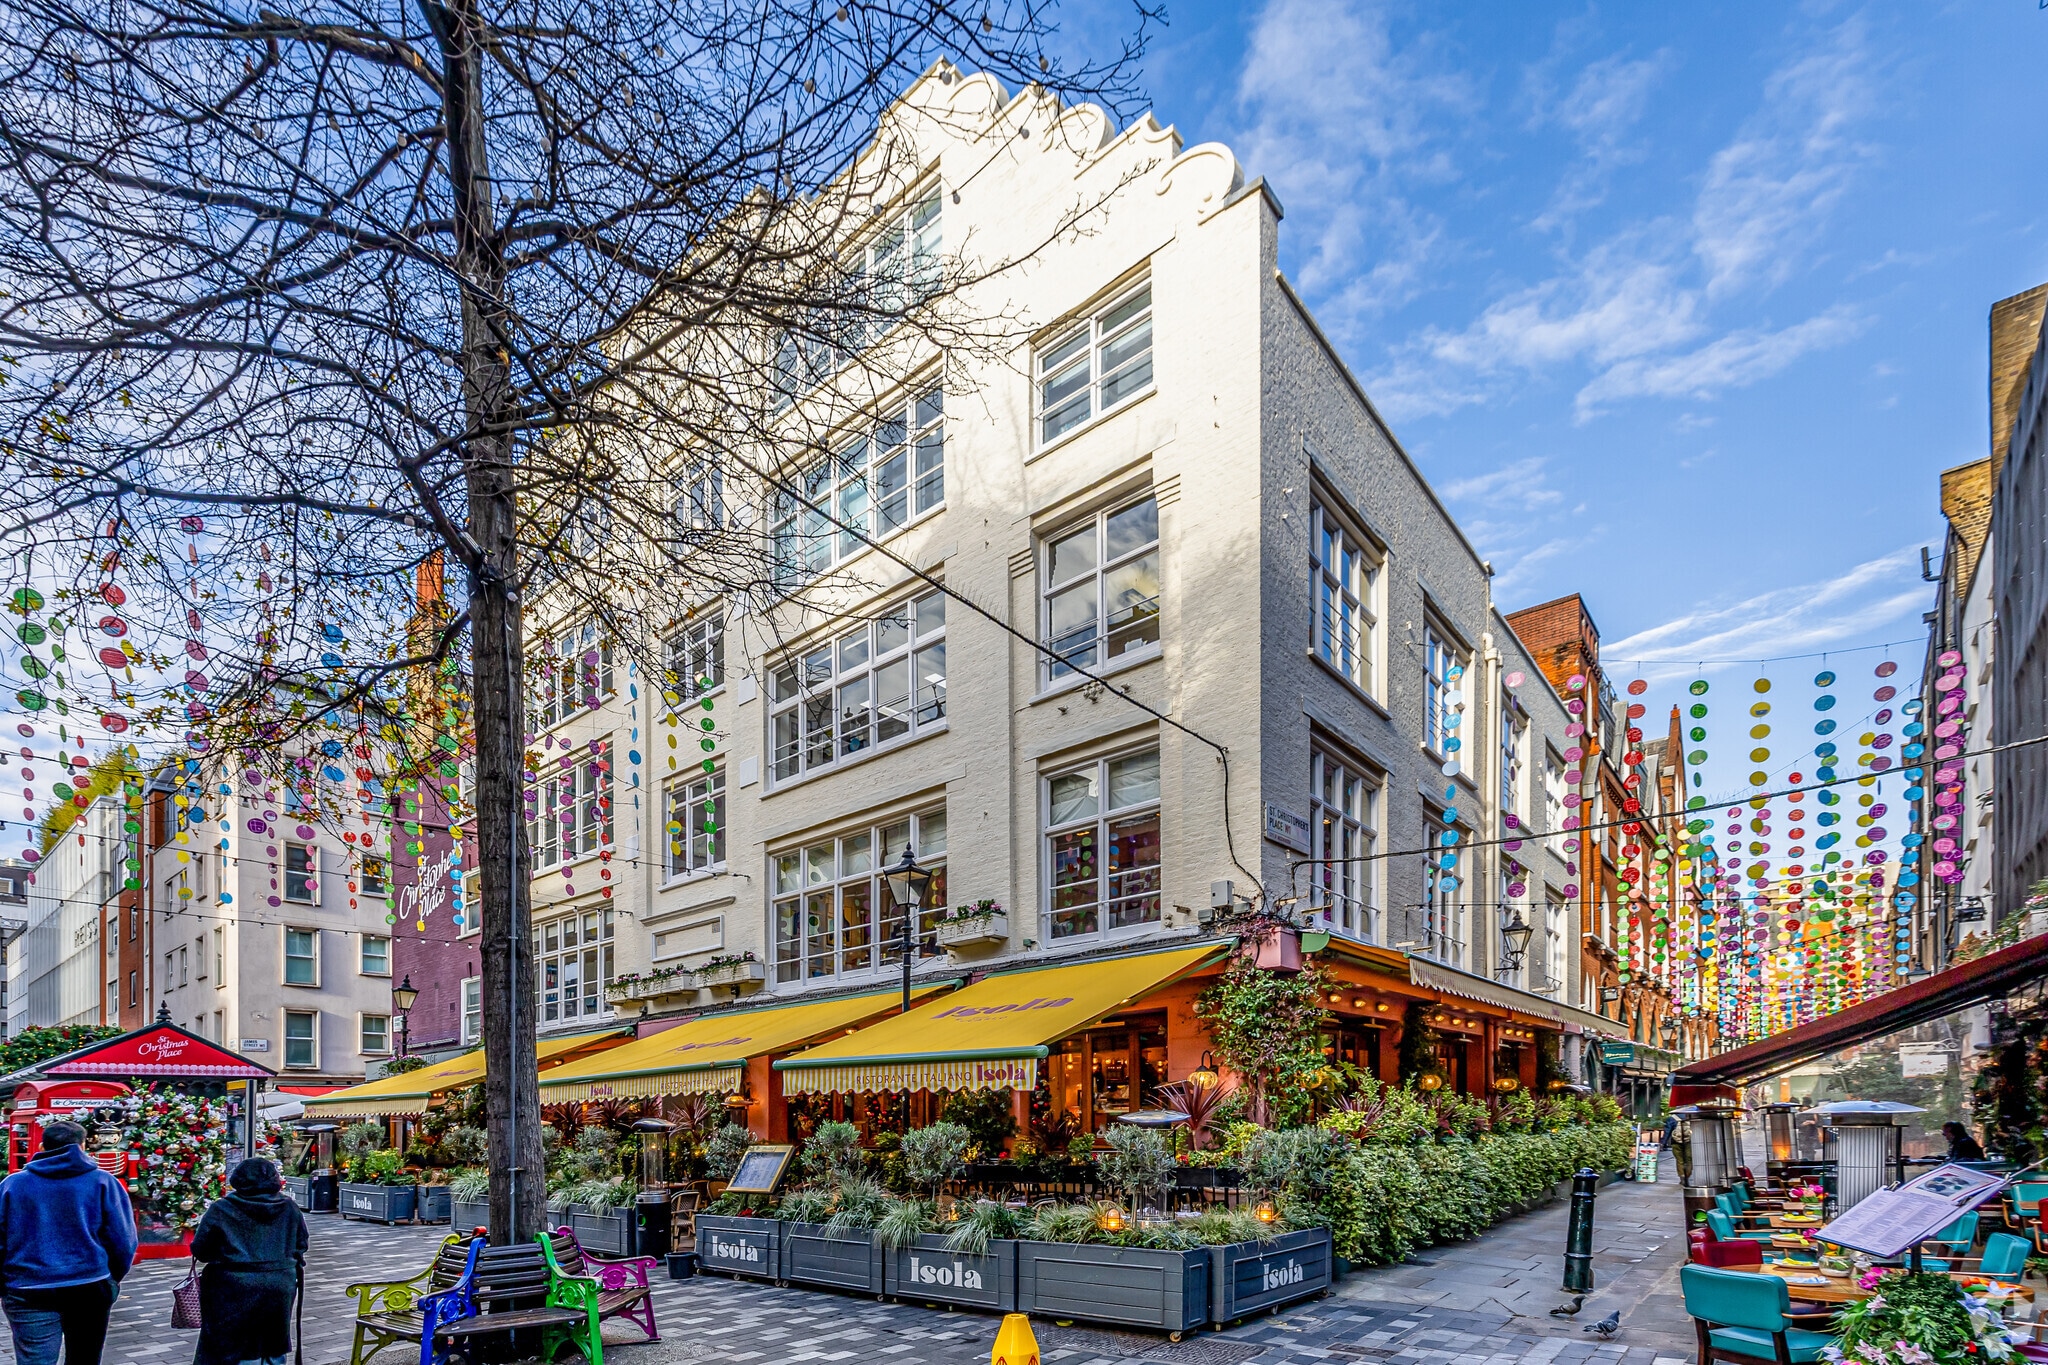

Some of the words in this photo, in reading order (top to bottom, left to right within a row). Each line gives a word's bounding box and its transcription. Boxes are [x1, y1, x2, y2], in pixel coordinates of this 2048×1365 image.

[1269, 805, 1277, 817] ST.
[1269, 817, 1283, 831] PLACE
[419, 885, 446, 922] Place
[74, 916, 99, 949] REISS
[138, 1040, 189, 1055] Christmas
[156, 1049, 182, 1061] Place
[856, 1073, 917, 1085] RISTORANTE
[920, 1071, 972, 1083] ITALIANO
[976, 1063, 1026, 1082] Isola
[591, 1083, 613, 1097] Isola
[660, 1079, 700, 1090] RISTORANTE
[702, 1076, 735, 1086] ITALIANO
[353, 1195, 372, 1210] Isola
[711, 1235, 759, 1262] Isola
[910, 1256, 983, 1290] Isola
[1262, 1258, 1304, 1291] Isola
